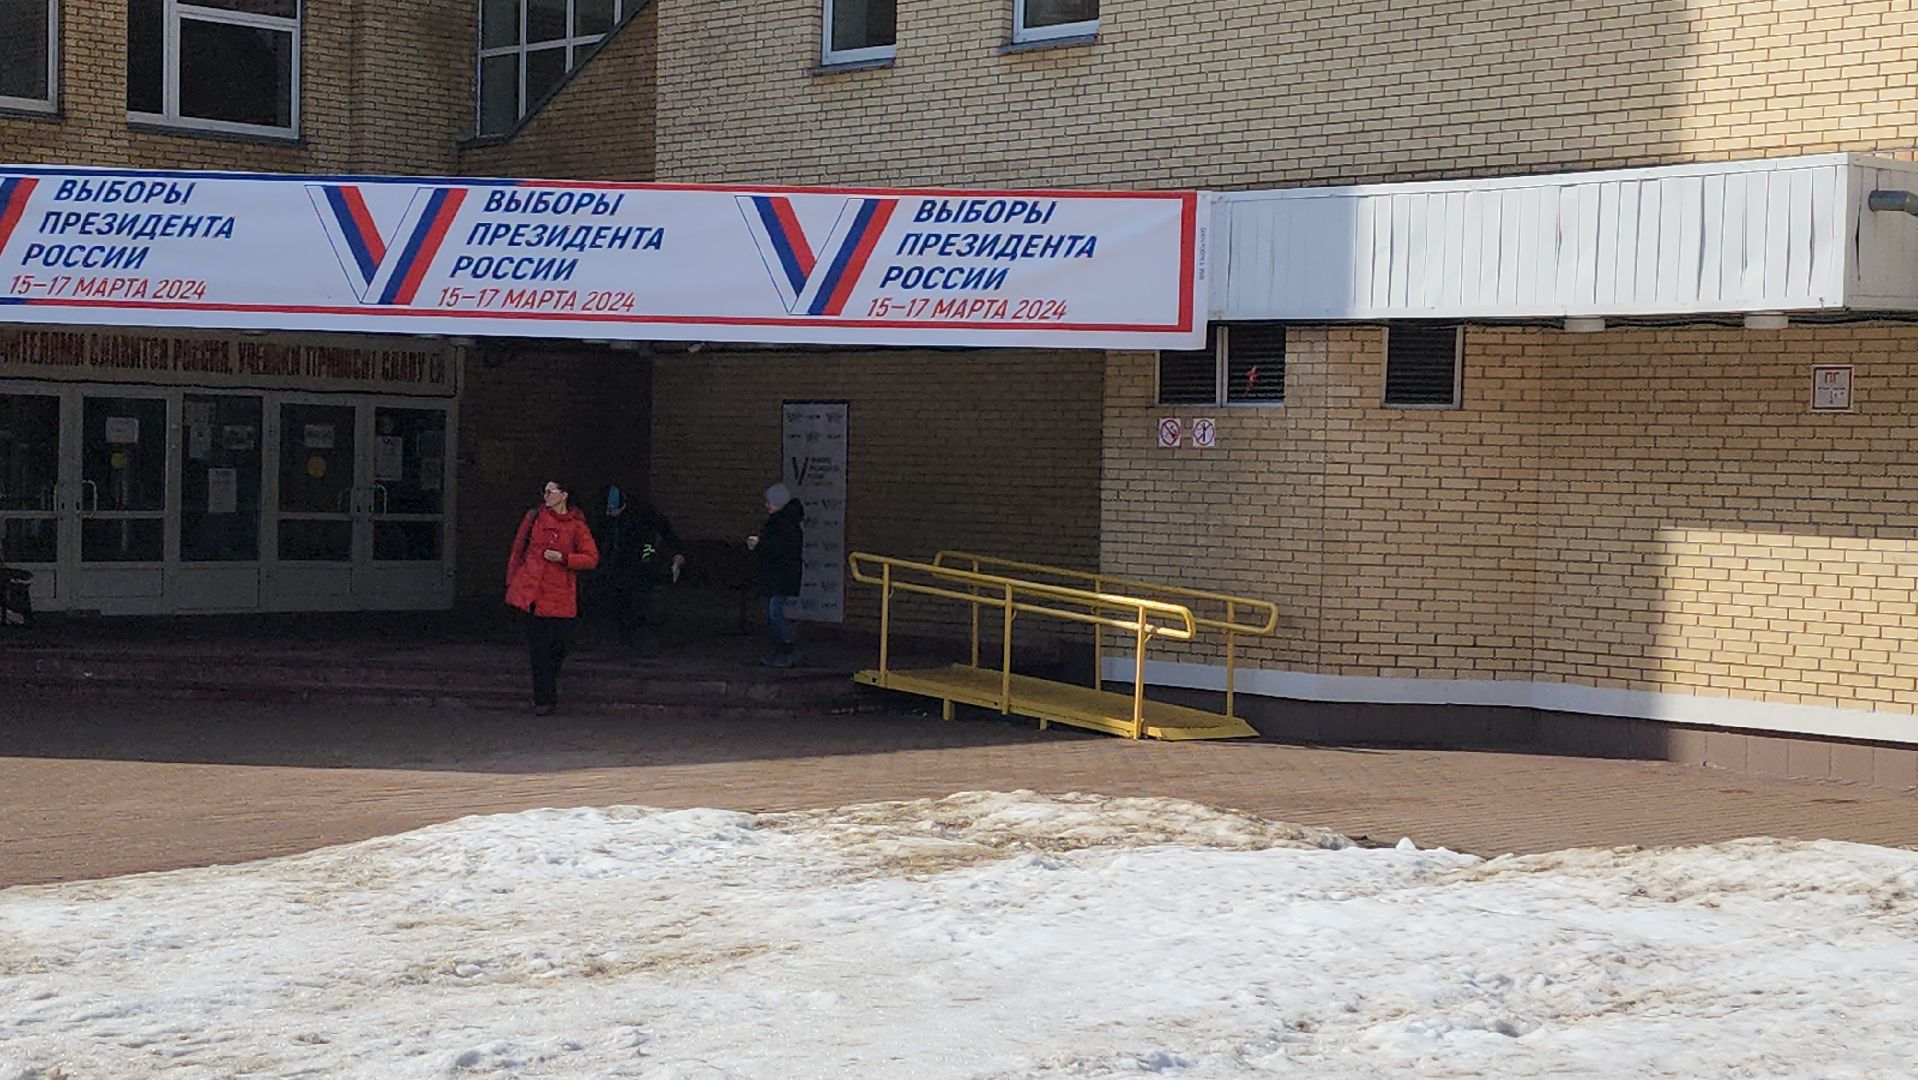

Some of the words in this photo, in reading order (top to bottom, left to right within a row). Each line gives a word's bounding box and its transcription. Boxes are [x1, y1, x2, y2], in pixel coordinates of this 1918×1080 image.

[54, 179, 197, 205] ВЫБОРЫ
[483, 190, 625, 216] ВЫБОРЫ
[913, 199, 1057, 225] ВЫБОРЫ
[38, 212, 235, 241] ПРЕЗИДЕНТА
[466, 223, 664, 252] ПРЕЗИДЕНТА
[21, 243, 150, 270] РОССИИ
[896, 233, 1098, 262] ПРЕЗИДЕНТА
[449, 256, 579, 282] РОССИИ
[879, 265, 1010, 291] РОССИИ
[72, 277, 148, 299] МАРТА
[153, 279, 208, 301] 2024
[501, 289, 577, 311] МАРТА
[581, 291, 637, 313] 2024
[931, 298, 1008, 320] МАРТА
[1012, 299, 1067, 321] 2024
